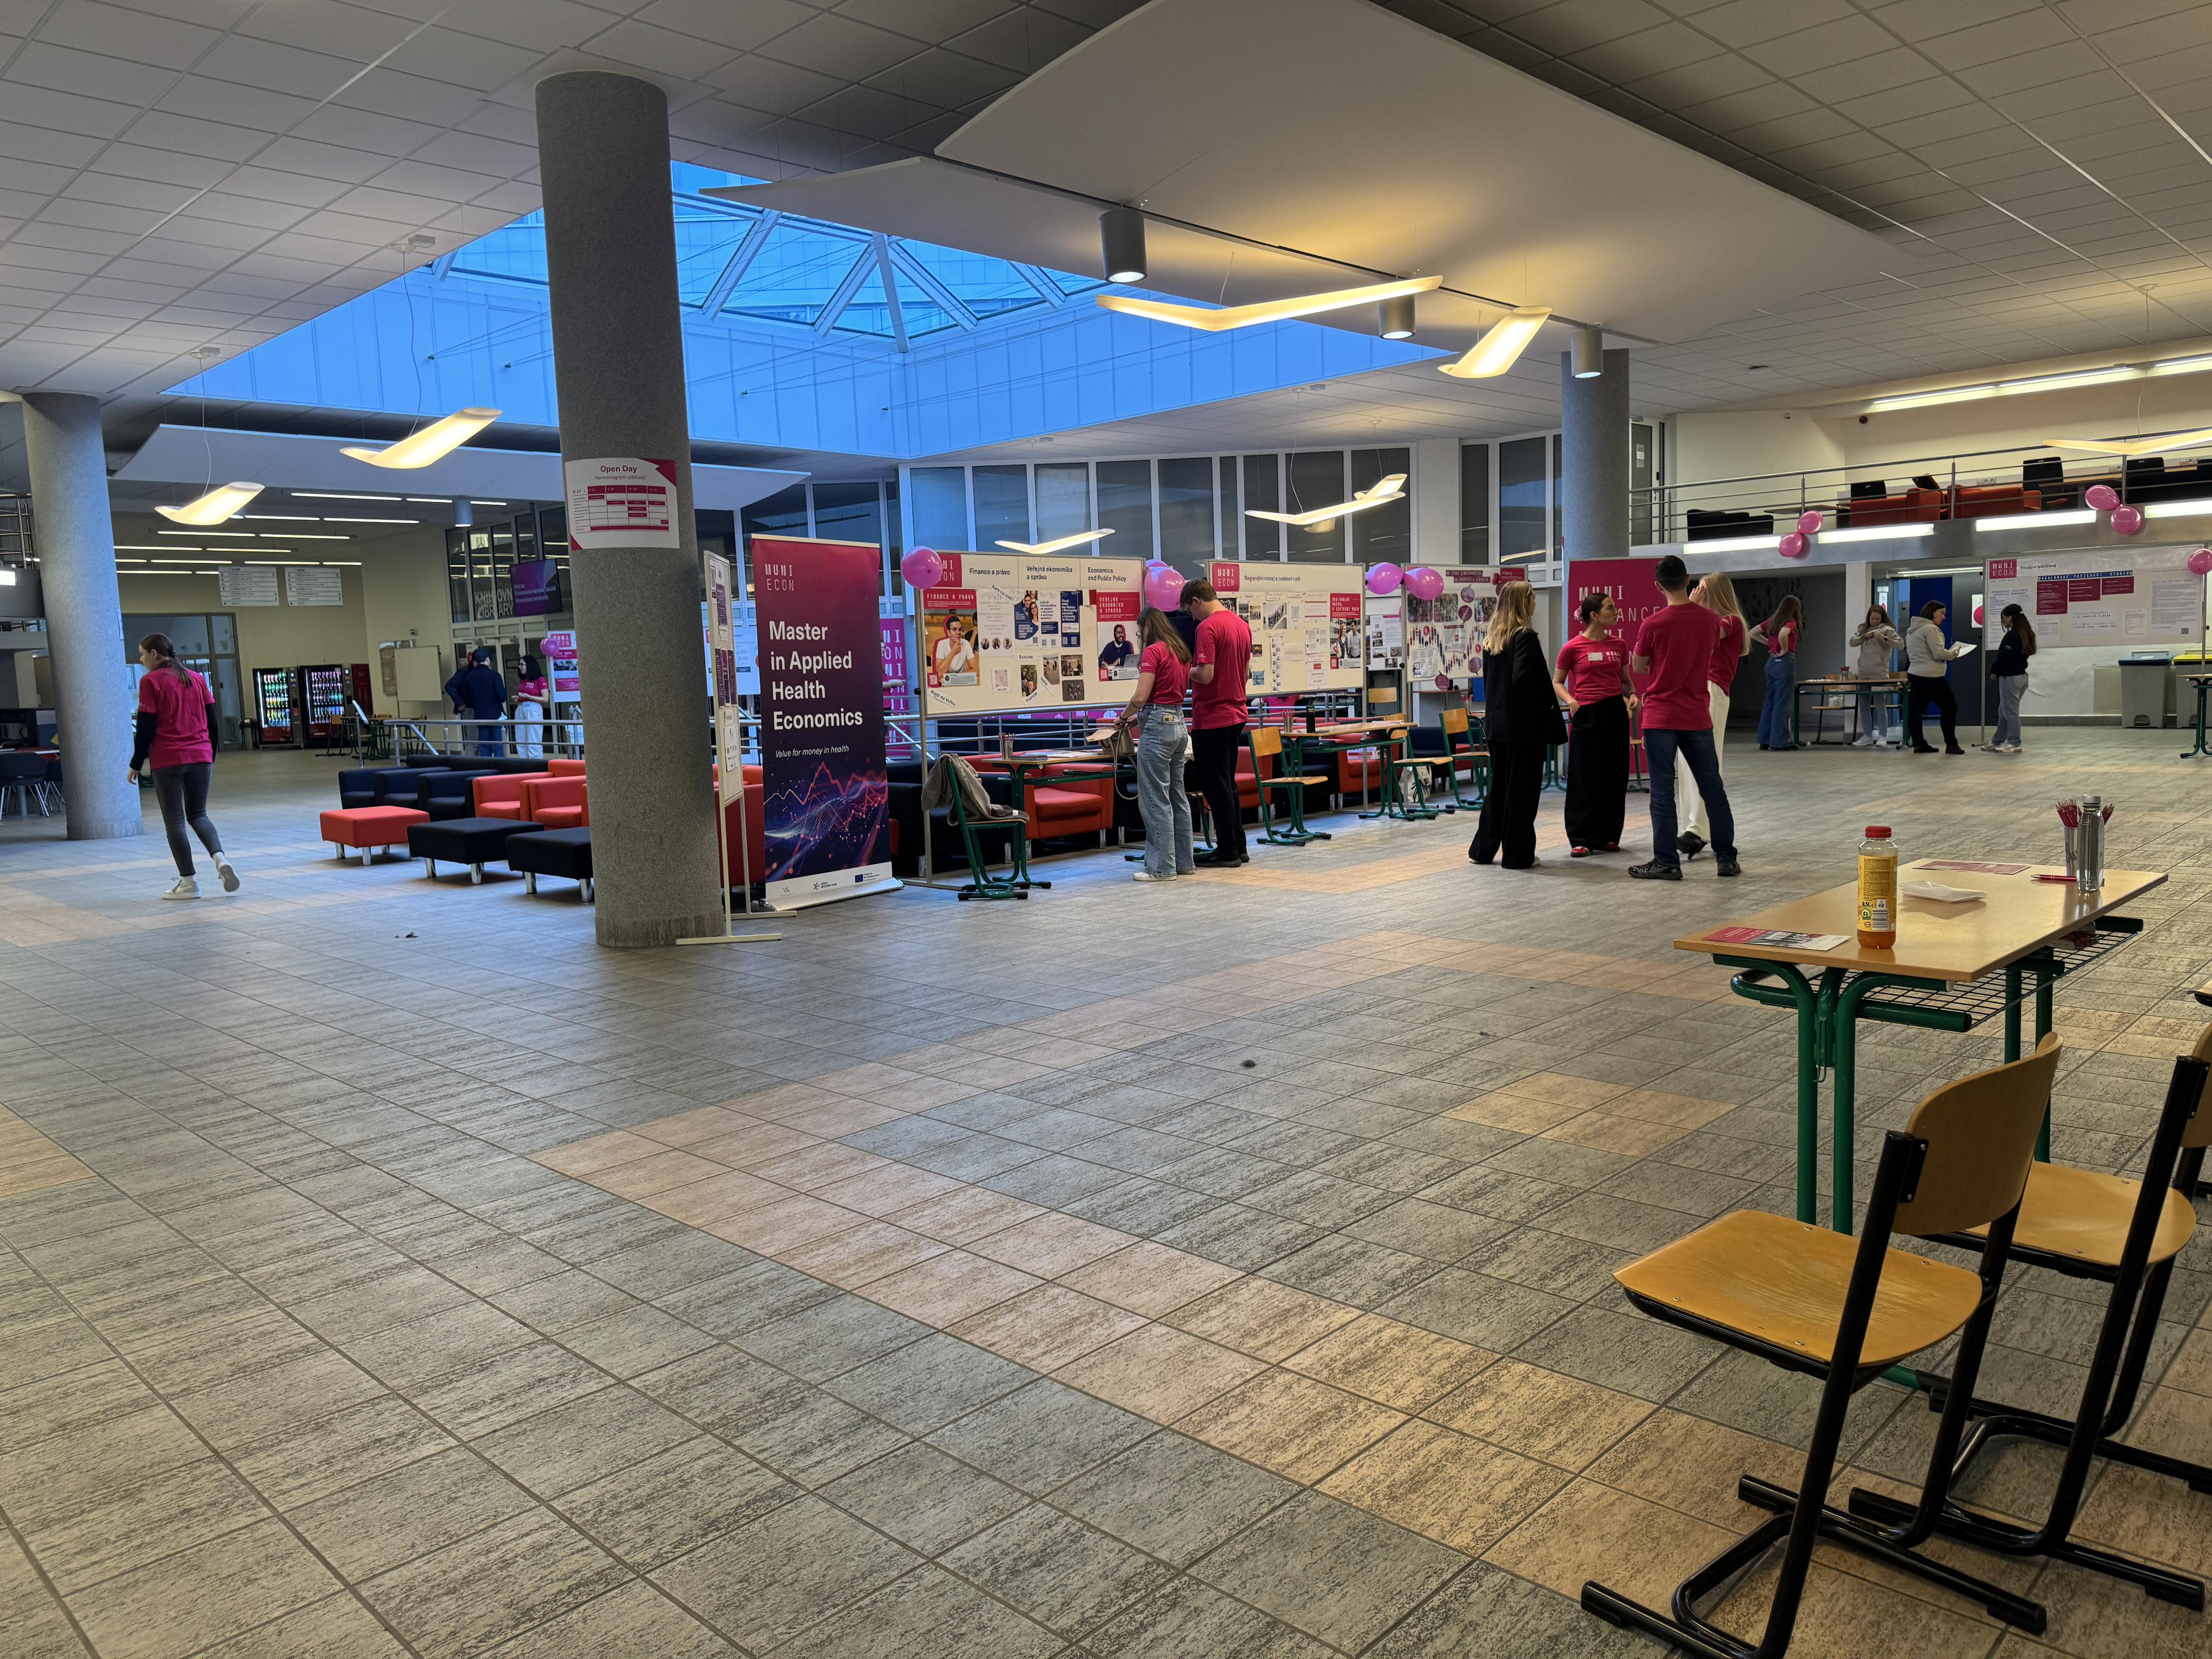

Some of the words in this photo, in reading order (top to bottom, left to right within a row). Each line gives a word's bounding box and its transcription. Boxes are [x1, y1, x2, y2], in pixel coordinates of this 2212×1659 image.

[765, 564, 793, 576] MUNI
[1217, 568, 1234, 577] MUNI
[766, 578, 794, 591] ECON
[477, 602, 514, 619] LIBRARY
[1616, 607, 1661, 623] ANCE
[769, 620, 828, 640] Master
[883, 629, 901, 643] NI
[884, 646, 903, 660] ON
[771, 651, 785, 670] in
[789, 650, 852, 674] Applied
[885, 663, 904, 677] NI
[772, 680, 826, 700] Health
[773, 708, 863, 731] Economics
[775, 749, 791, 758] Value
[792, 748, 801, 757] for
[802, 748, 823, 756] money
[831, 745, 849, 753] health
